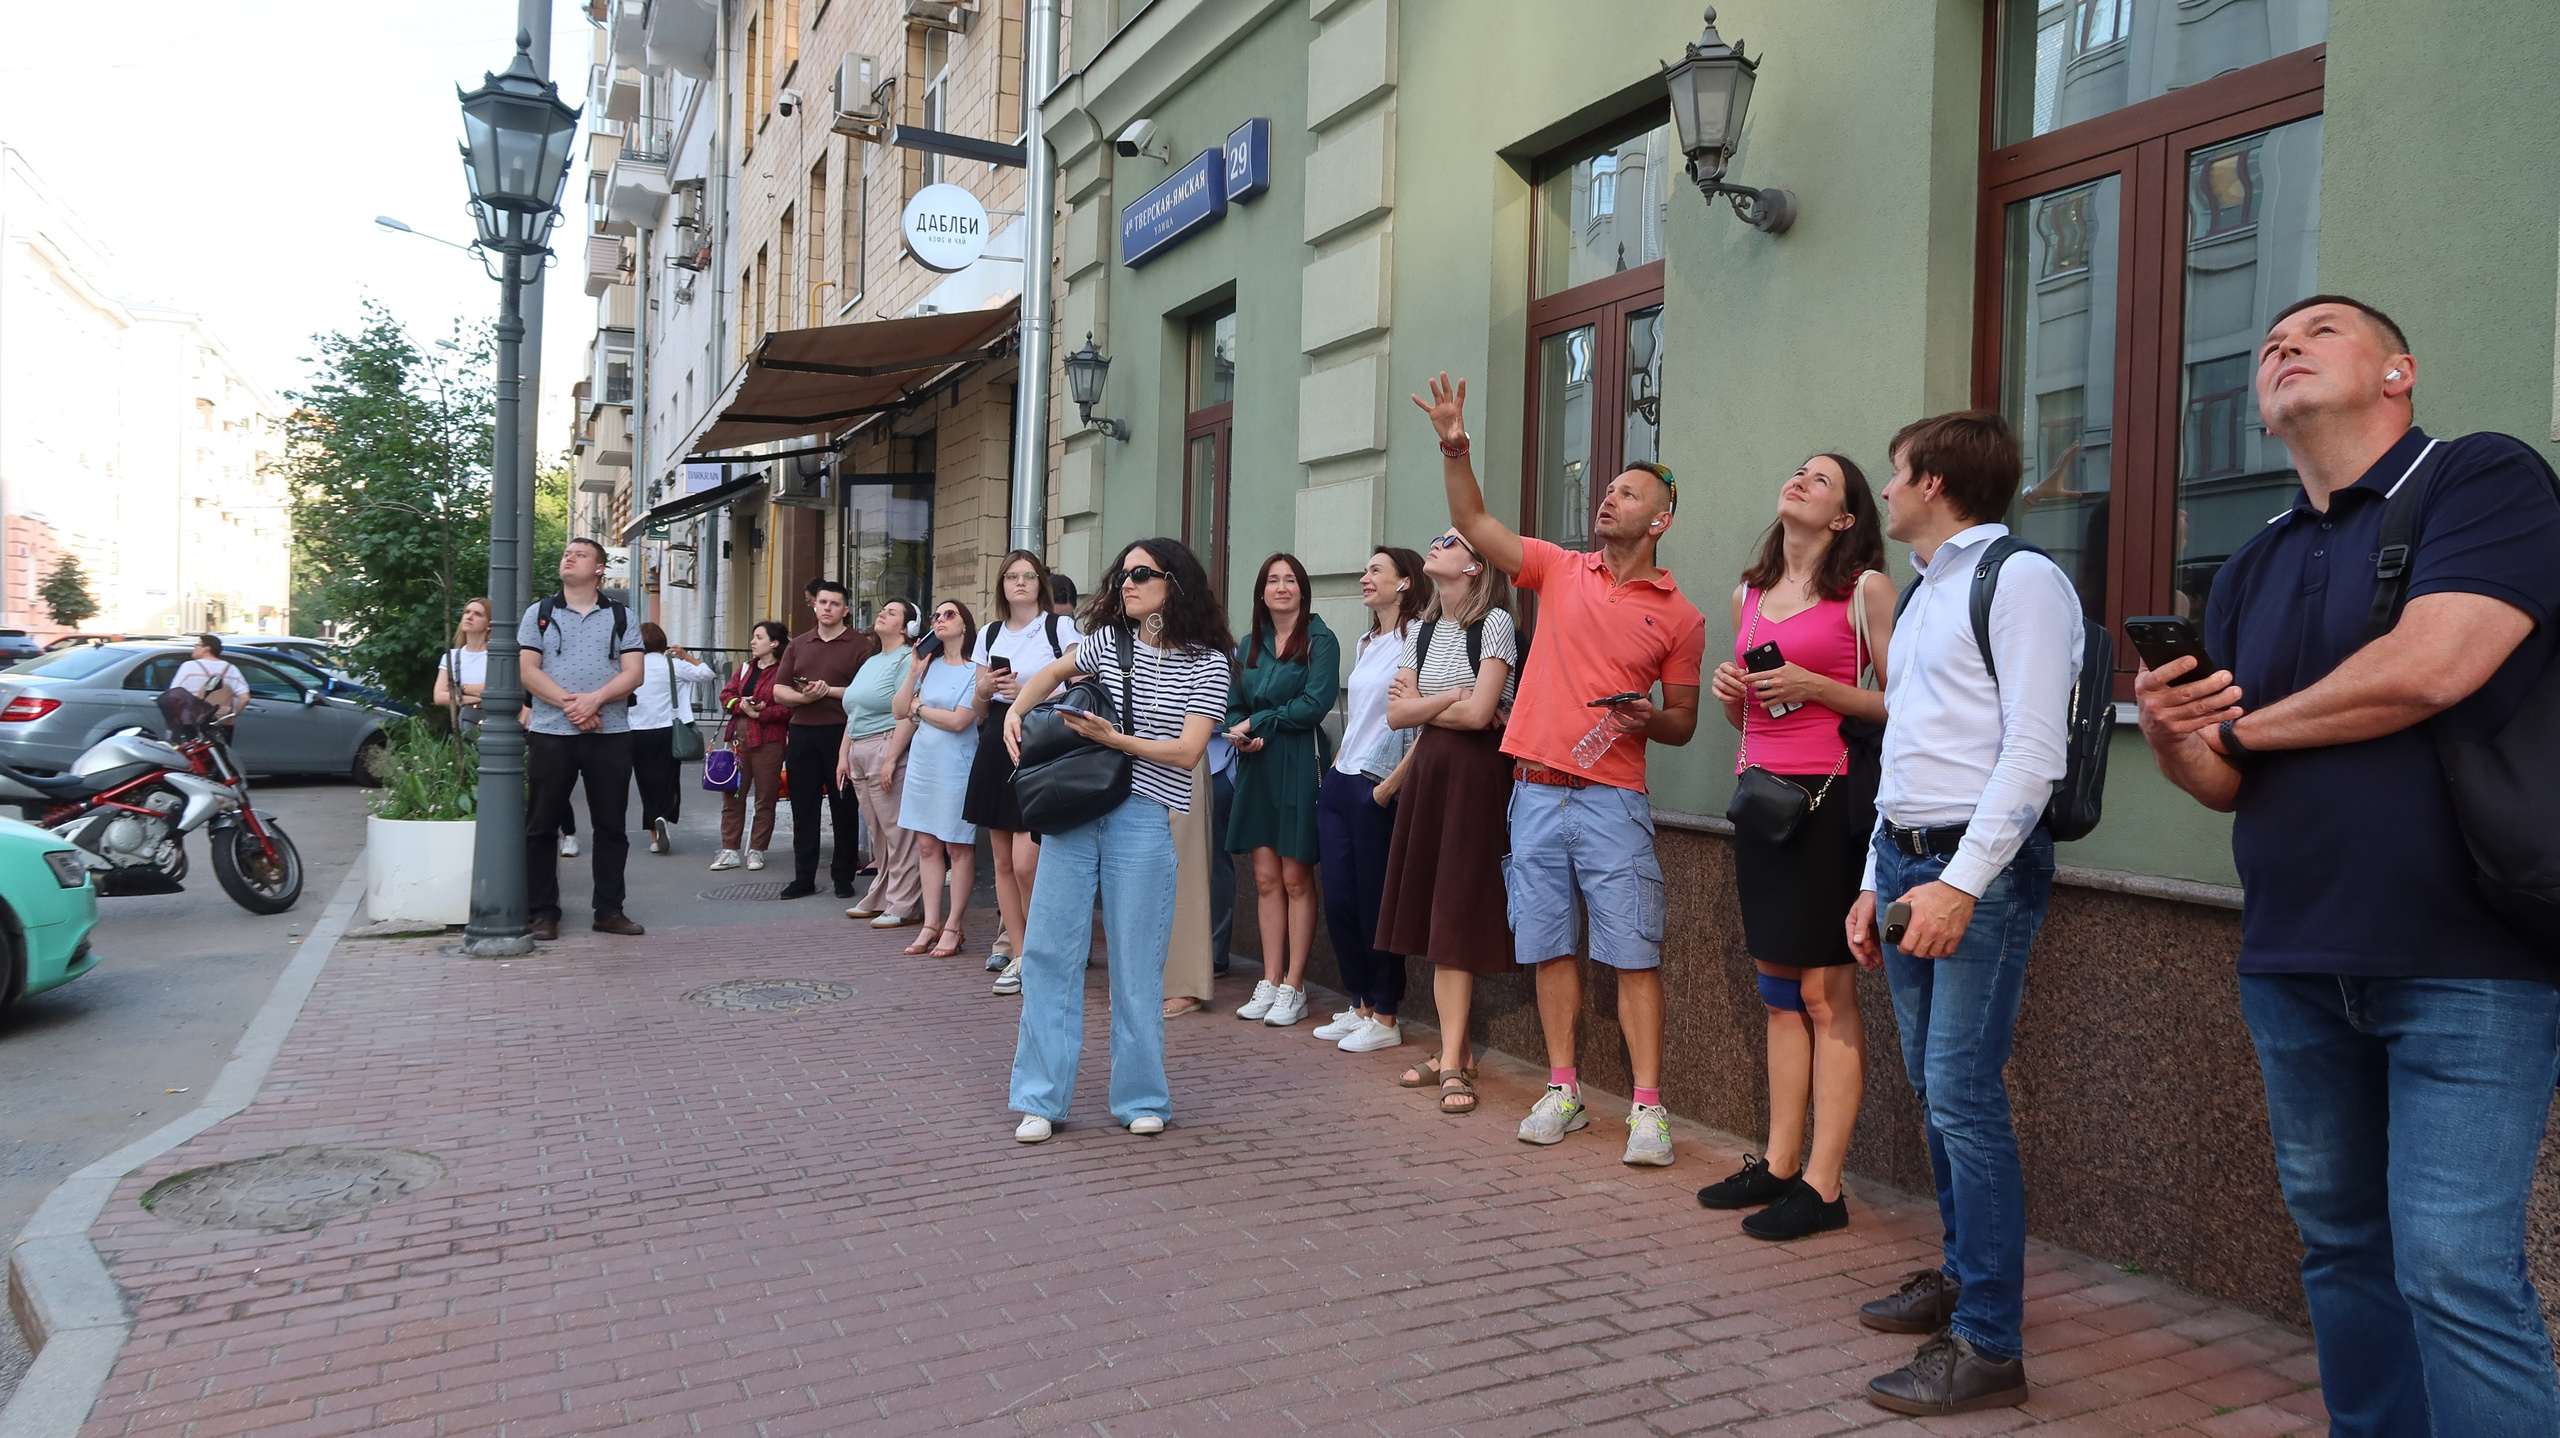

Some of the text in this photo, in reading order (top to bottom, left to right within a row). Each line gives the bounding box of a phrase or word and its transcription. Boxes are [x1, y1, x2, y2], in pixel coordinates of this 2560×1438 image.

[1230, 141, 1247, 181] 29
[1134, 168, 1205, 232] ТВЕРСКАЯ-ЯМСКАЯ
[916, 213, 978, 235] ДАБЛБИ
[1154, 217, 1174, 236] УЛИЦА
[954, 236, 966, 244] ЧАЙ
